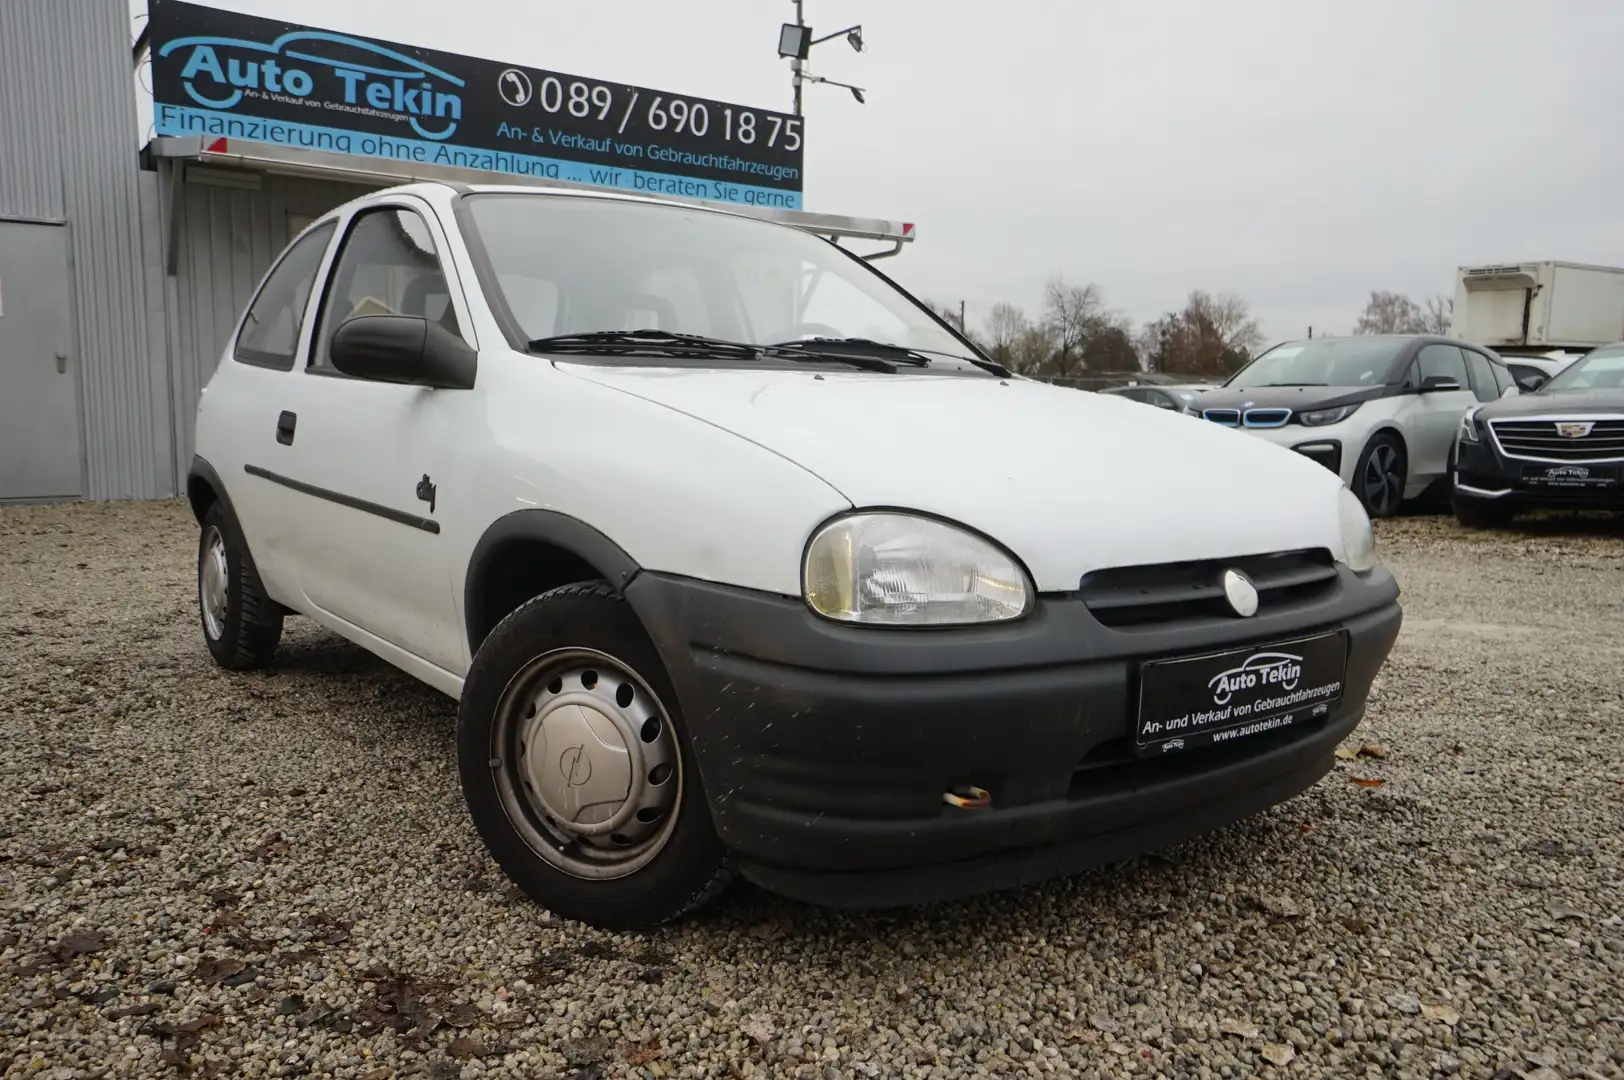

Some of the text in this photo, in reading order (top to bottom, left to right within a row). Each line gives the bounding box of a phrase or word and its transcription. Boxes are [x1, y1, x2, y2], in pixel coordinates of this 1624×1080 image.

[180, 45, 462, 120] Auto Tekin
[271, 94, 303, 105] Verkauf
[305, 99, 321, 108] von
[540, 77, 801, 151] 089 / 690 18 75
[161, 105, 351, 153] Finanzierung
[362, 136, 426, 162] ohne
[434, 145, 559, 180] Anzahlung
[589, 167, 622, 185] wir
[633, 171, 707, 197] beraten
[713, 182, 739, 201] Sie
[744, 189, 795, 208] gerne
[496, 122, 798, 181] An- & Verkauf von Gebrauchtfahrzeugen
[1216, 663, 1301, 694] Auto Tekin
[1142, 720, 1163, 735] An-
[1166, 714, 1189, 730] und
[1191, 705, 1232, 726] Verkauf
[1233, 703, 1251, 718] von
[1253, 681, 1340, 712] Gebrauchtfahrzeugen
[1212, 714, 1293, 742] www.autotekin.de
